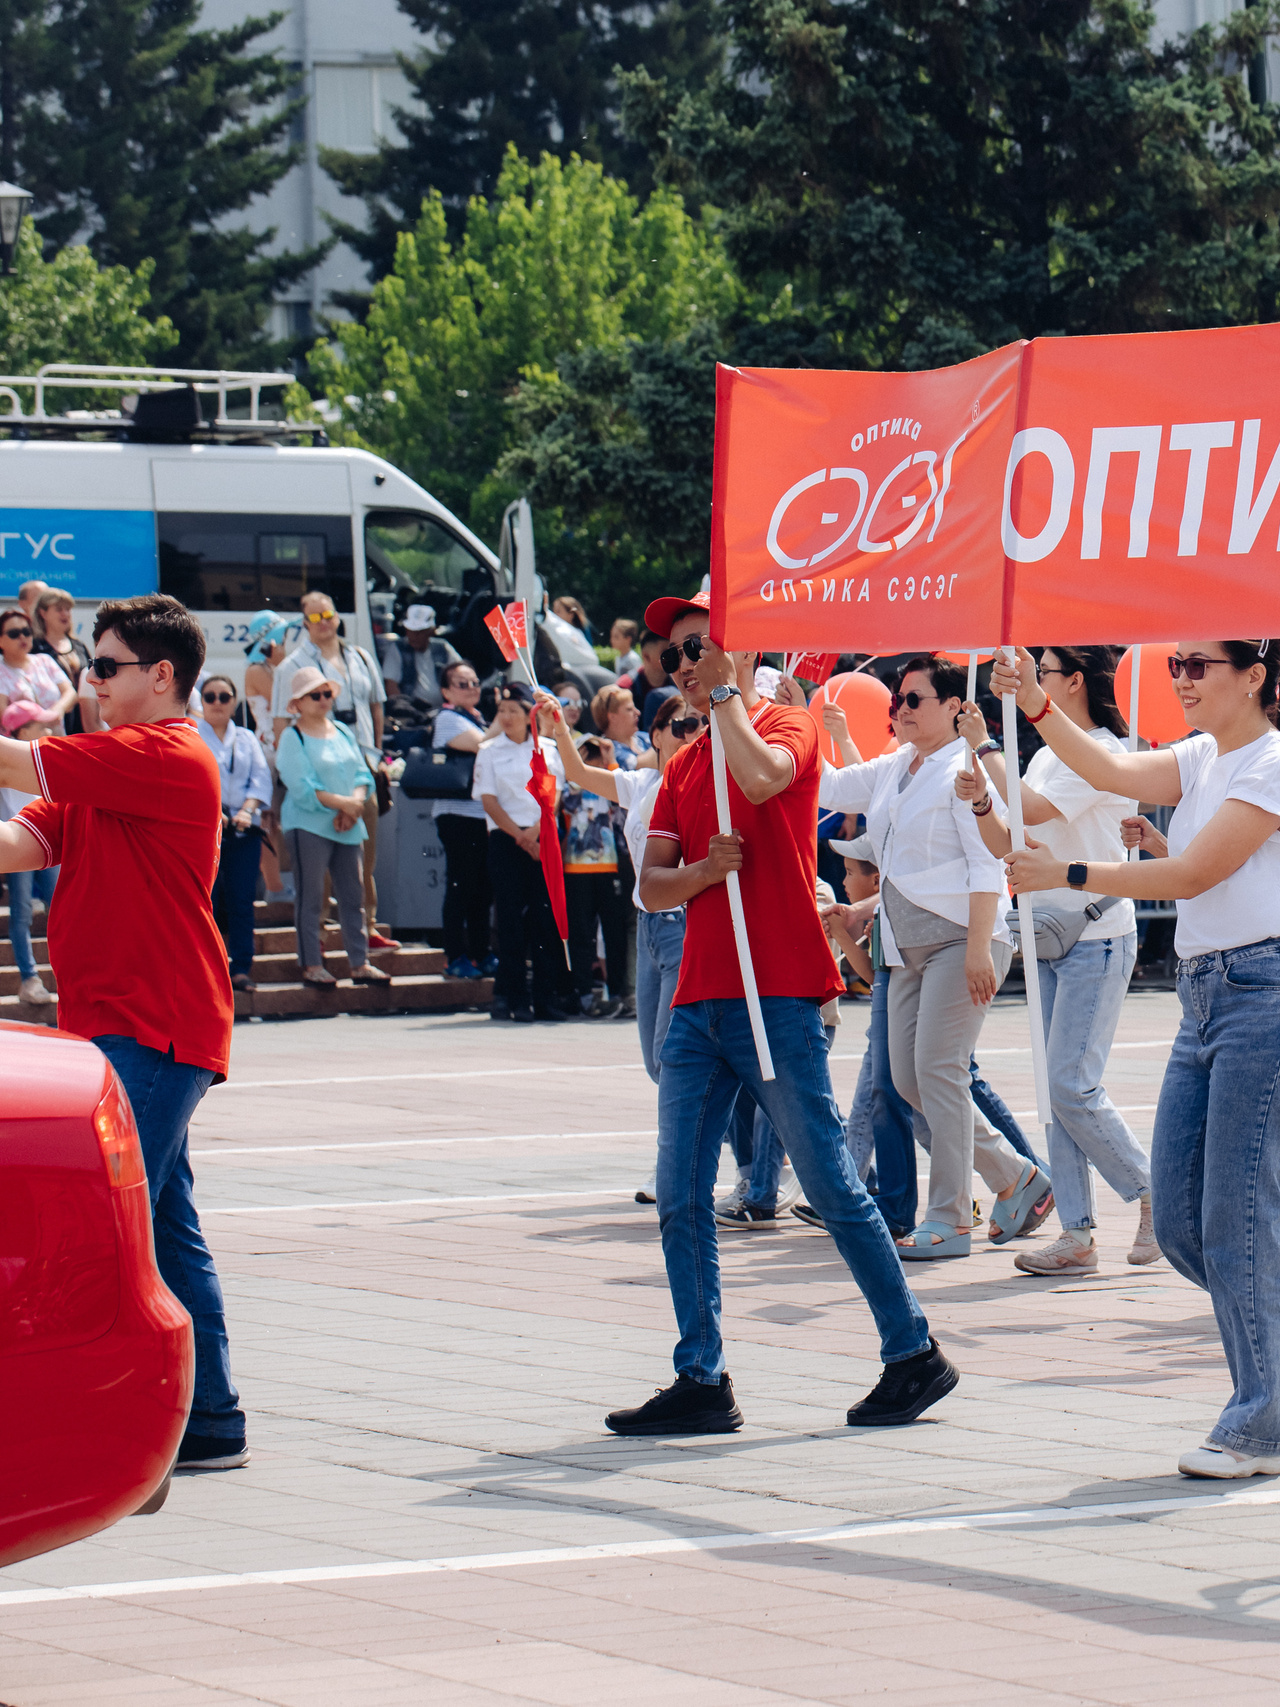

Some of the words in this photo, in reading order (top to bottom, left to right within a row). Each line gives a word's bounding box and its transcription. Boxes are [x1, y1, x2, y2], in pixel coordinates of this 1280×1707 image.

[851, 417, 922, 452] оптика
[759, 578, 870, 602] ОПТИКА
[887, 573, 958, 601] СЭСЭГ
